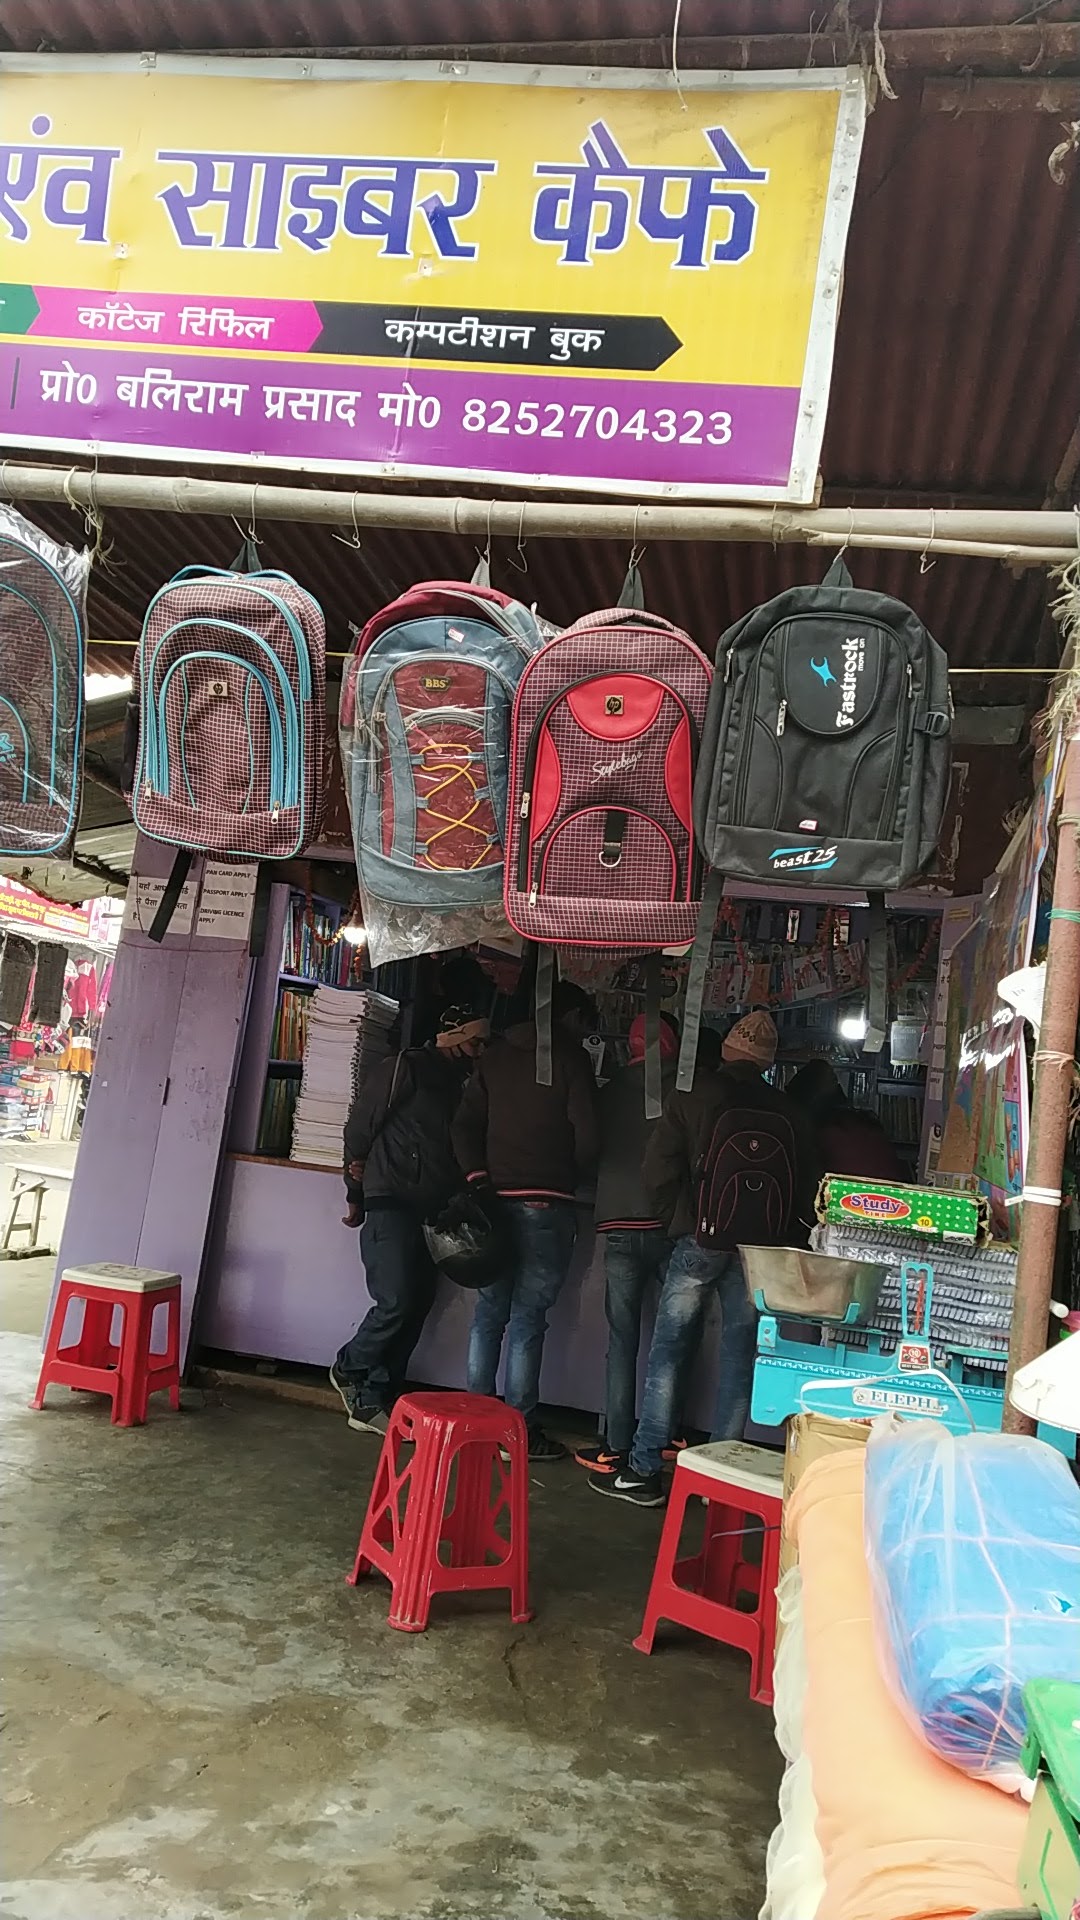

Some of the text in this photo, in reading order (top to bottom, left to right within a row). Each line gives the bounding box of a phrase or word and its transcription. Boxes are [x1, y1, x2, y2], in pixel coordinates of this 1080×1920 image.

[155, 150, 498, 260] साइबर
[531, 118, 769, 270] कैफे
[77, 302, 275, 340] कॉटेज रिफिल
[385, 316, 605, 361] कम्पटीशन बुक
[115, 368, 249, 417] बलिराम
[262, 385, 362, 427] प्रसाद
[461, 398, 733, 446] 8252704323
[857, 651, 865, 672] move
[233, 871, 251, 879] APPLY
[202, 888, 249, 898] PASSPORT APPLY
[222, 910, 246, 918] LICENCE
[851, 1194, 901, 1214] Study
[919, 1218, 930, 1227] 10
